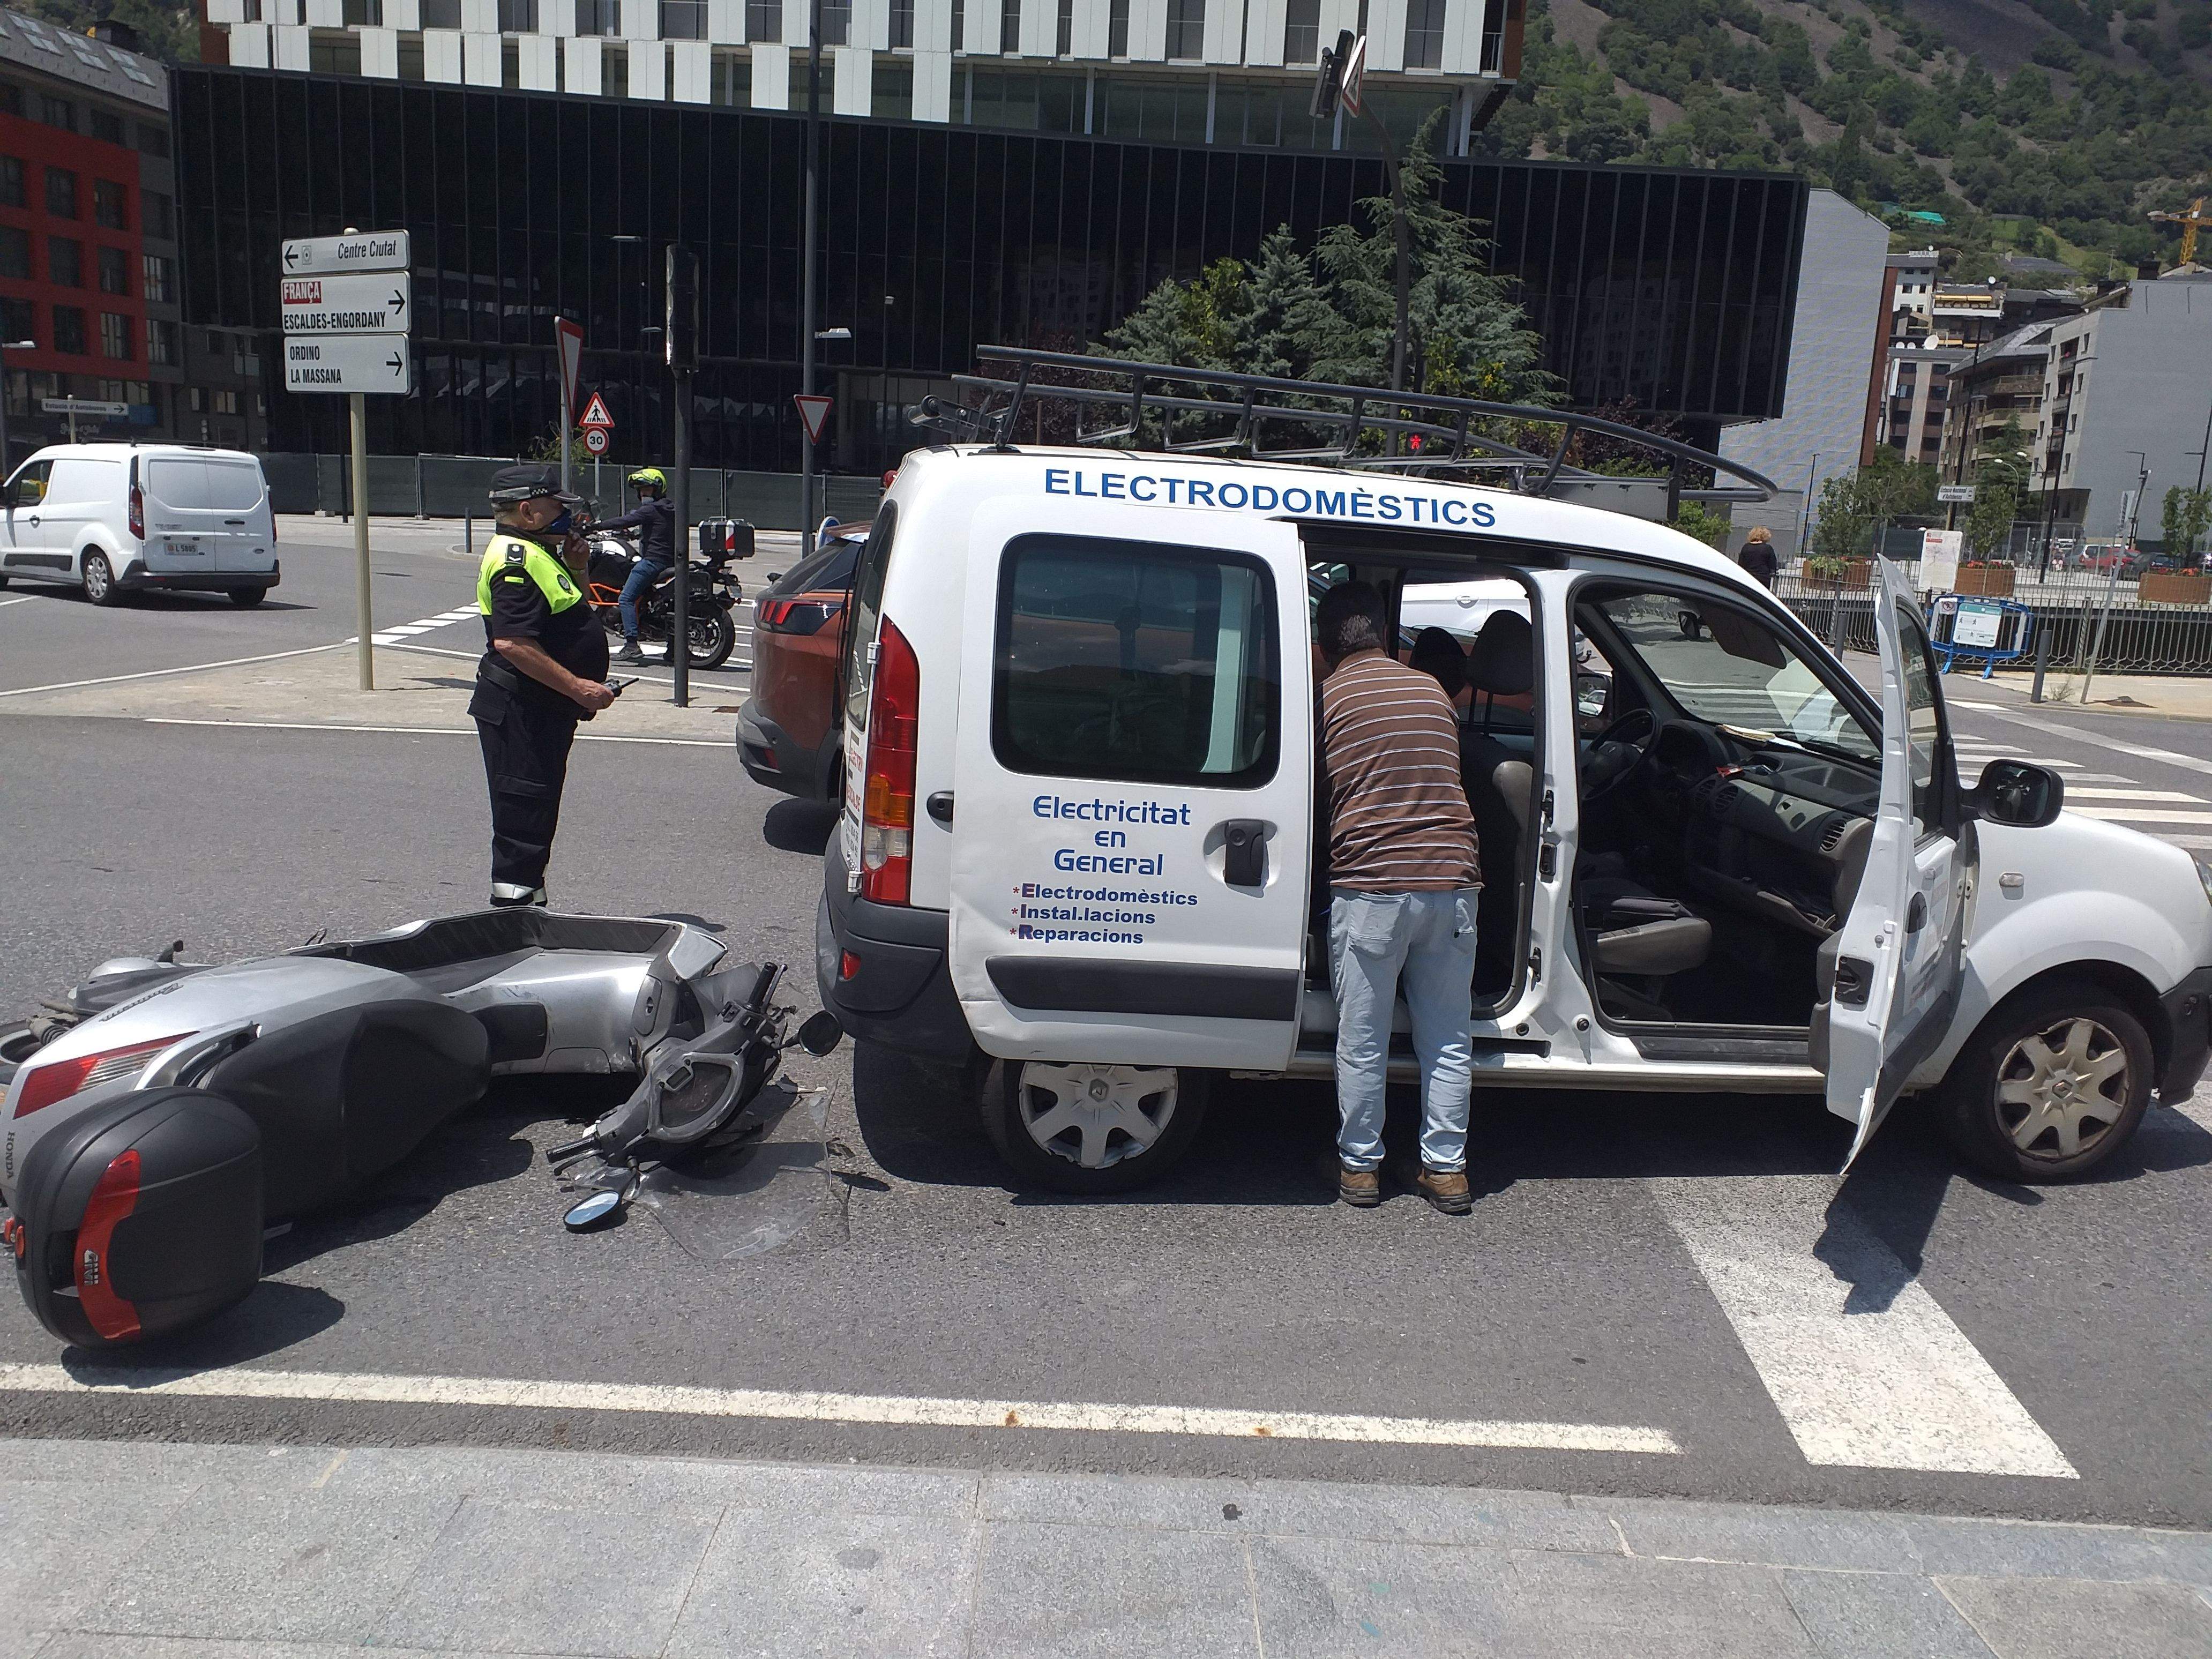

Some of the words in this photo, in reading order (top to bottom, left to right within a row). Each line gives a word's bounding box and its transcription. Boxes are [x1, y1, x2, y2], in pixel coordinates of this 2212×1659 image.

[338, 242, 366, 259] Centre
[370, 240, 397, 257] Ciutat
[283, 281, 320, 303] FRANÇA
[284, 311, 386, 330] ESCALDES-ENGORDANY
[290, 346, 320, 361] ORDINO
[290, 369, 301, 383] LA
[303, 369, 342, 384] MASSANA
[589, 436, 603, 445] 30
[1044, 467, 1496, 528] ELECTRODOMÈSTICS
[1033, 795, 1191, 826] Electricitat
[1094, 831, 1126, 848] en
[1054, 849, 1163, 876] General
[1021, 883, 1198, 906] Electrodomèstics
[1020, 903, 1156, 924] Instal.lacions
[1018, 924, 1144, 944] Reparacions
[6, 1131, 16, 1179] HONDA
